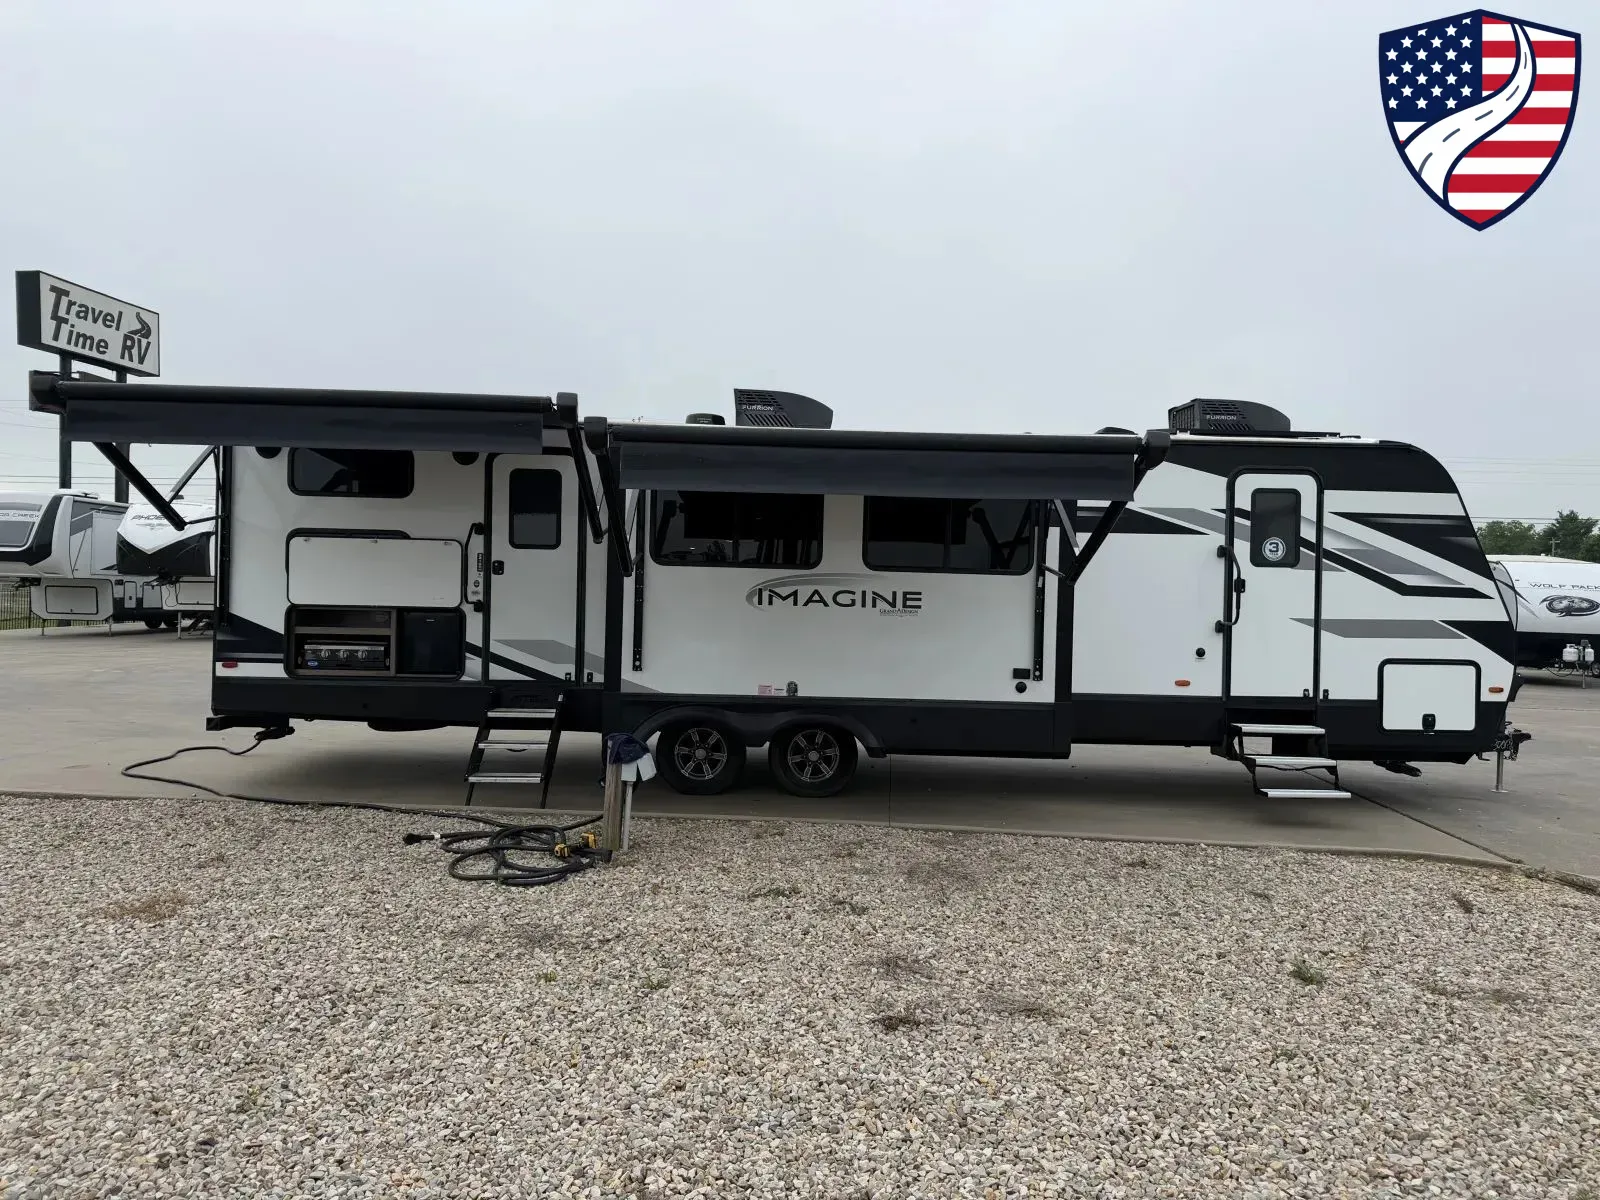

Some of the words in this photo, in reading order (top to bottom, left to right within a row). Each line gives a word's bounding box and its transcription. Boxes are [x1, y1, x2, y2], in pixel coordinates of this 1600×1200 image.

[49, 284, 123, 332] Travel
[50, 315, 109, 355] Time
[120, 333, 151, 365] RV
[1269, 542, 1279, 552] 3
[757, 587, 922, 609] IMAGINE
